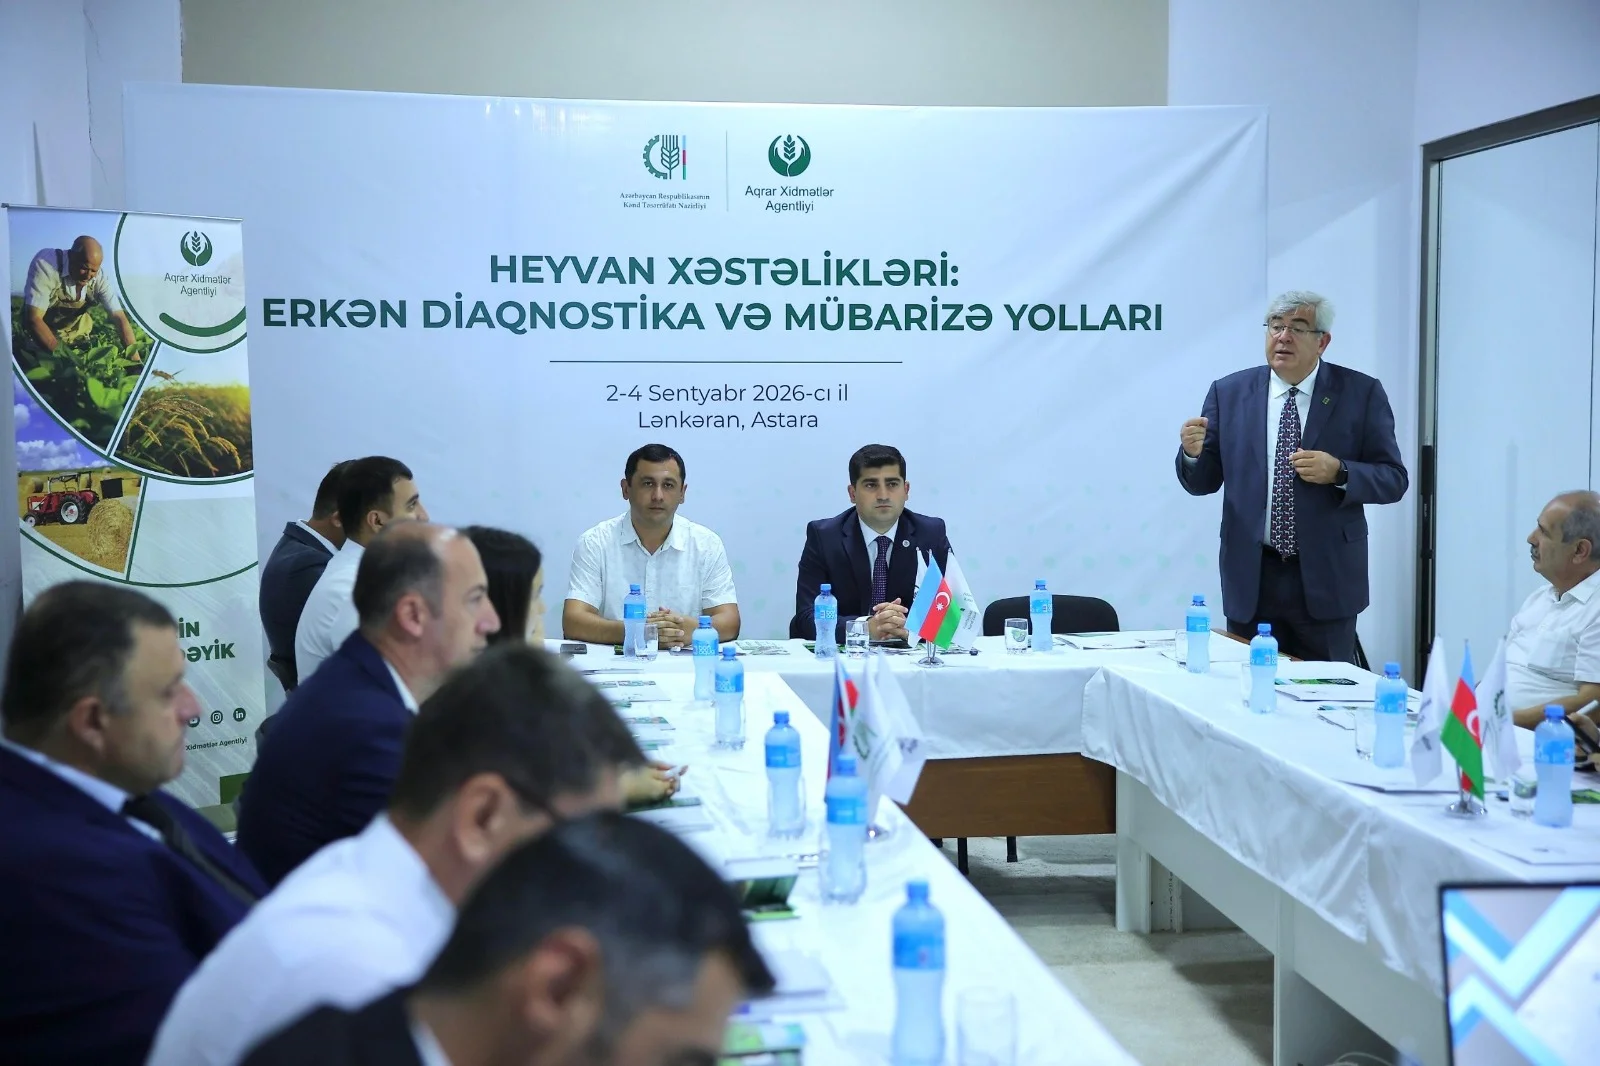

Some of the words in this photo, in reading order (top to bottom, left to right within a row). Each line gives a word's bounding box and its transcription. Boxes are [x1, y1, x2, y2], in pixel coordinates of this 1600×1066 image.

[745, 185, 777, 199] Aqrar
[780, 185, 835, 198] Xidmətlər
[765, 200, 814, 214] Agentliyi
[490, 254, 655, 285] HEYVAN
[667, 249, 959, 287] XƏSTƏLİKLƏRİ:
[164, 272, 189, 285] Aqrar
[190, 273, 232, 285] Xidmətlər
[180, 285, 217, 298] Agentliyi
[262, 298, 407, 329] ERKƏN
[423, 291, 706, 335] DİAQNOSTİKA
[714, 302, 772, 331] VƏ
[785, 295, 993, 332] MÜBARİZƏ
[1003, 303, 1162, 332] YOLLARI
[606, 384, 643, 402] 2-4
[648, 383, 747, 406] Sentyabr
[752, 384, 832, 403] 2026-cı
[838, 383, 849, 402] il
[637, 410, 747, 431] Lənkəran,
[750, 411, 819, 429] Astara
[181, 638, 236, 663] ƏYİK
[219, 736, 248, 747] Agentliyi
